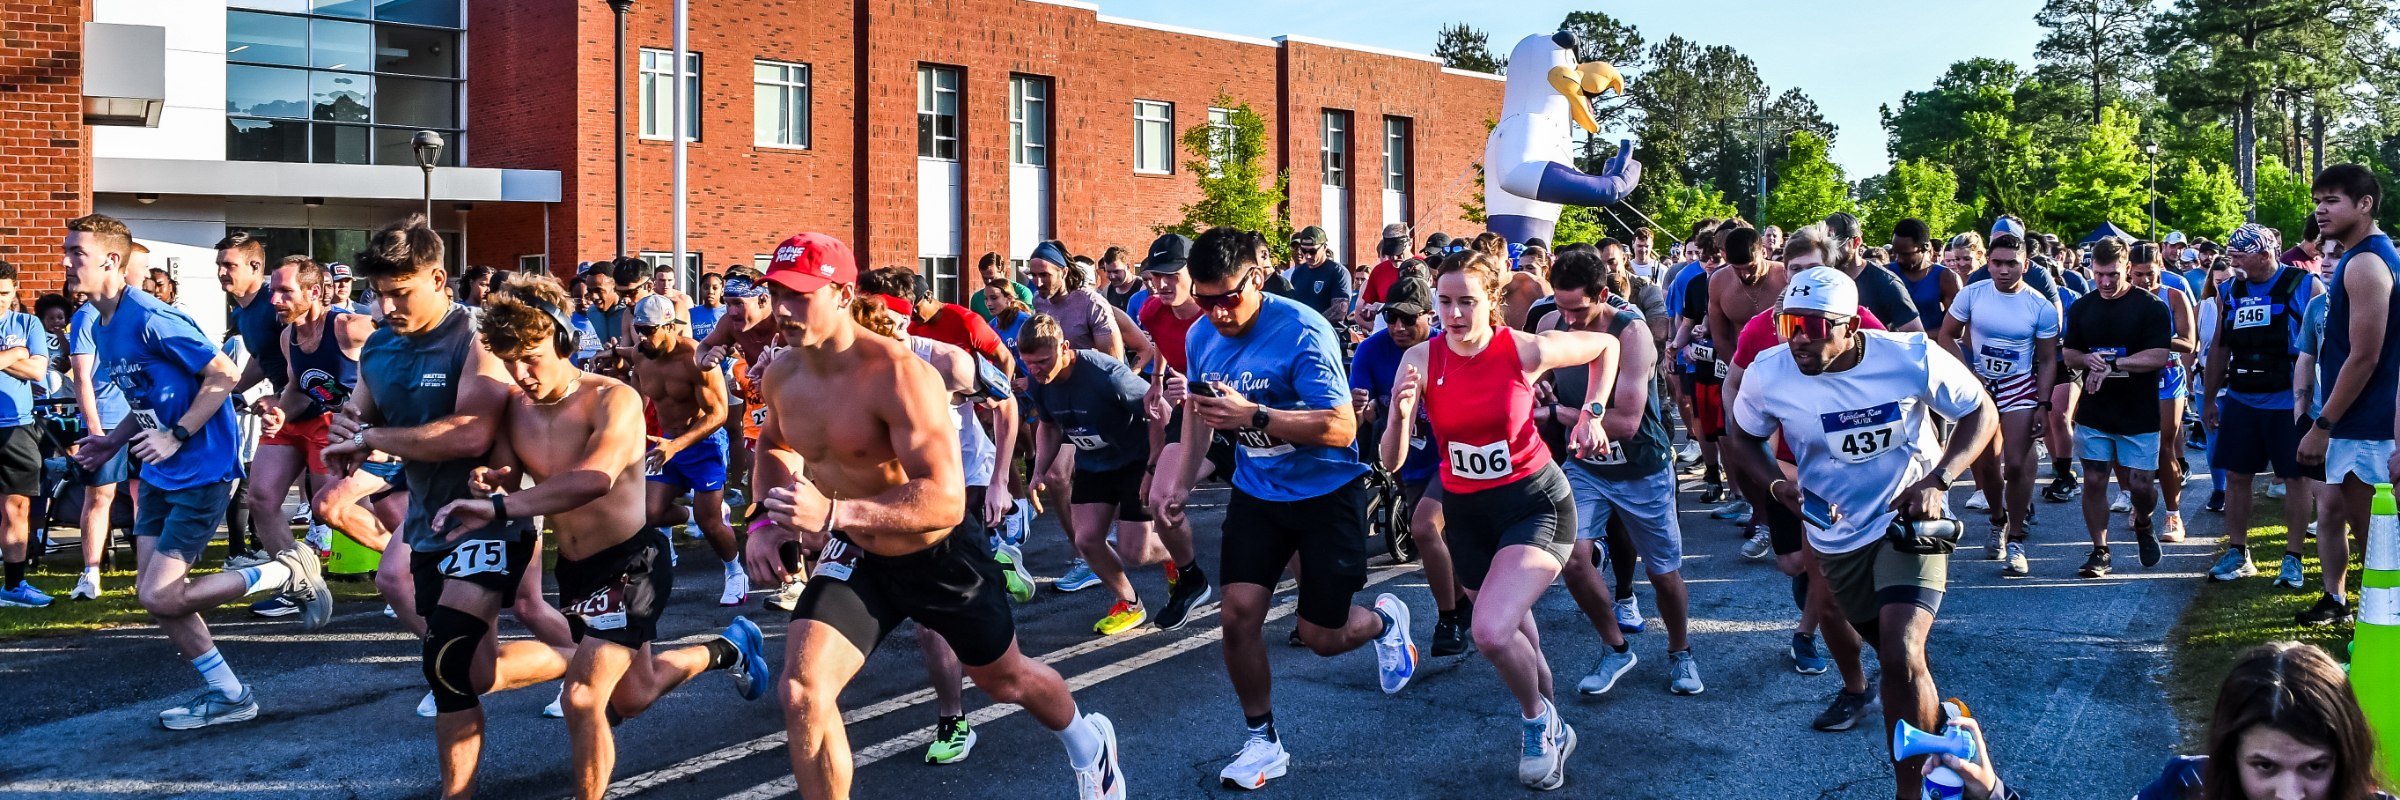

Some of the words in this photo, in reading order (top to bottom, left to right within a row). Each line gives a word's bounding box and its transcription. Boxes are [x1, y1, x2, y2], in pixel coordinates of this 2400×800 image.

[2238, 308, 2264, 324] 546
[1695, 346, 1709, 359] 487
[1985, 358, 2012, 373] 157
[1240, 371, 1270, 392] Run
[1841, 427, 1893, 456] 437
[1453, 449, 1507, 475] 106
[445, 541, 501, 575] 275
